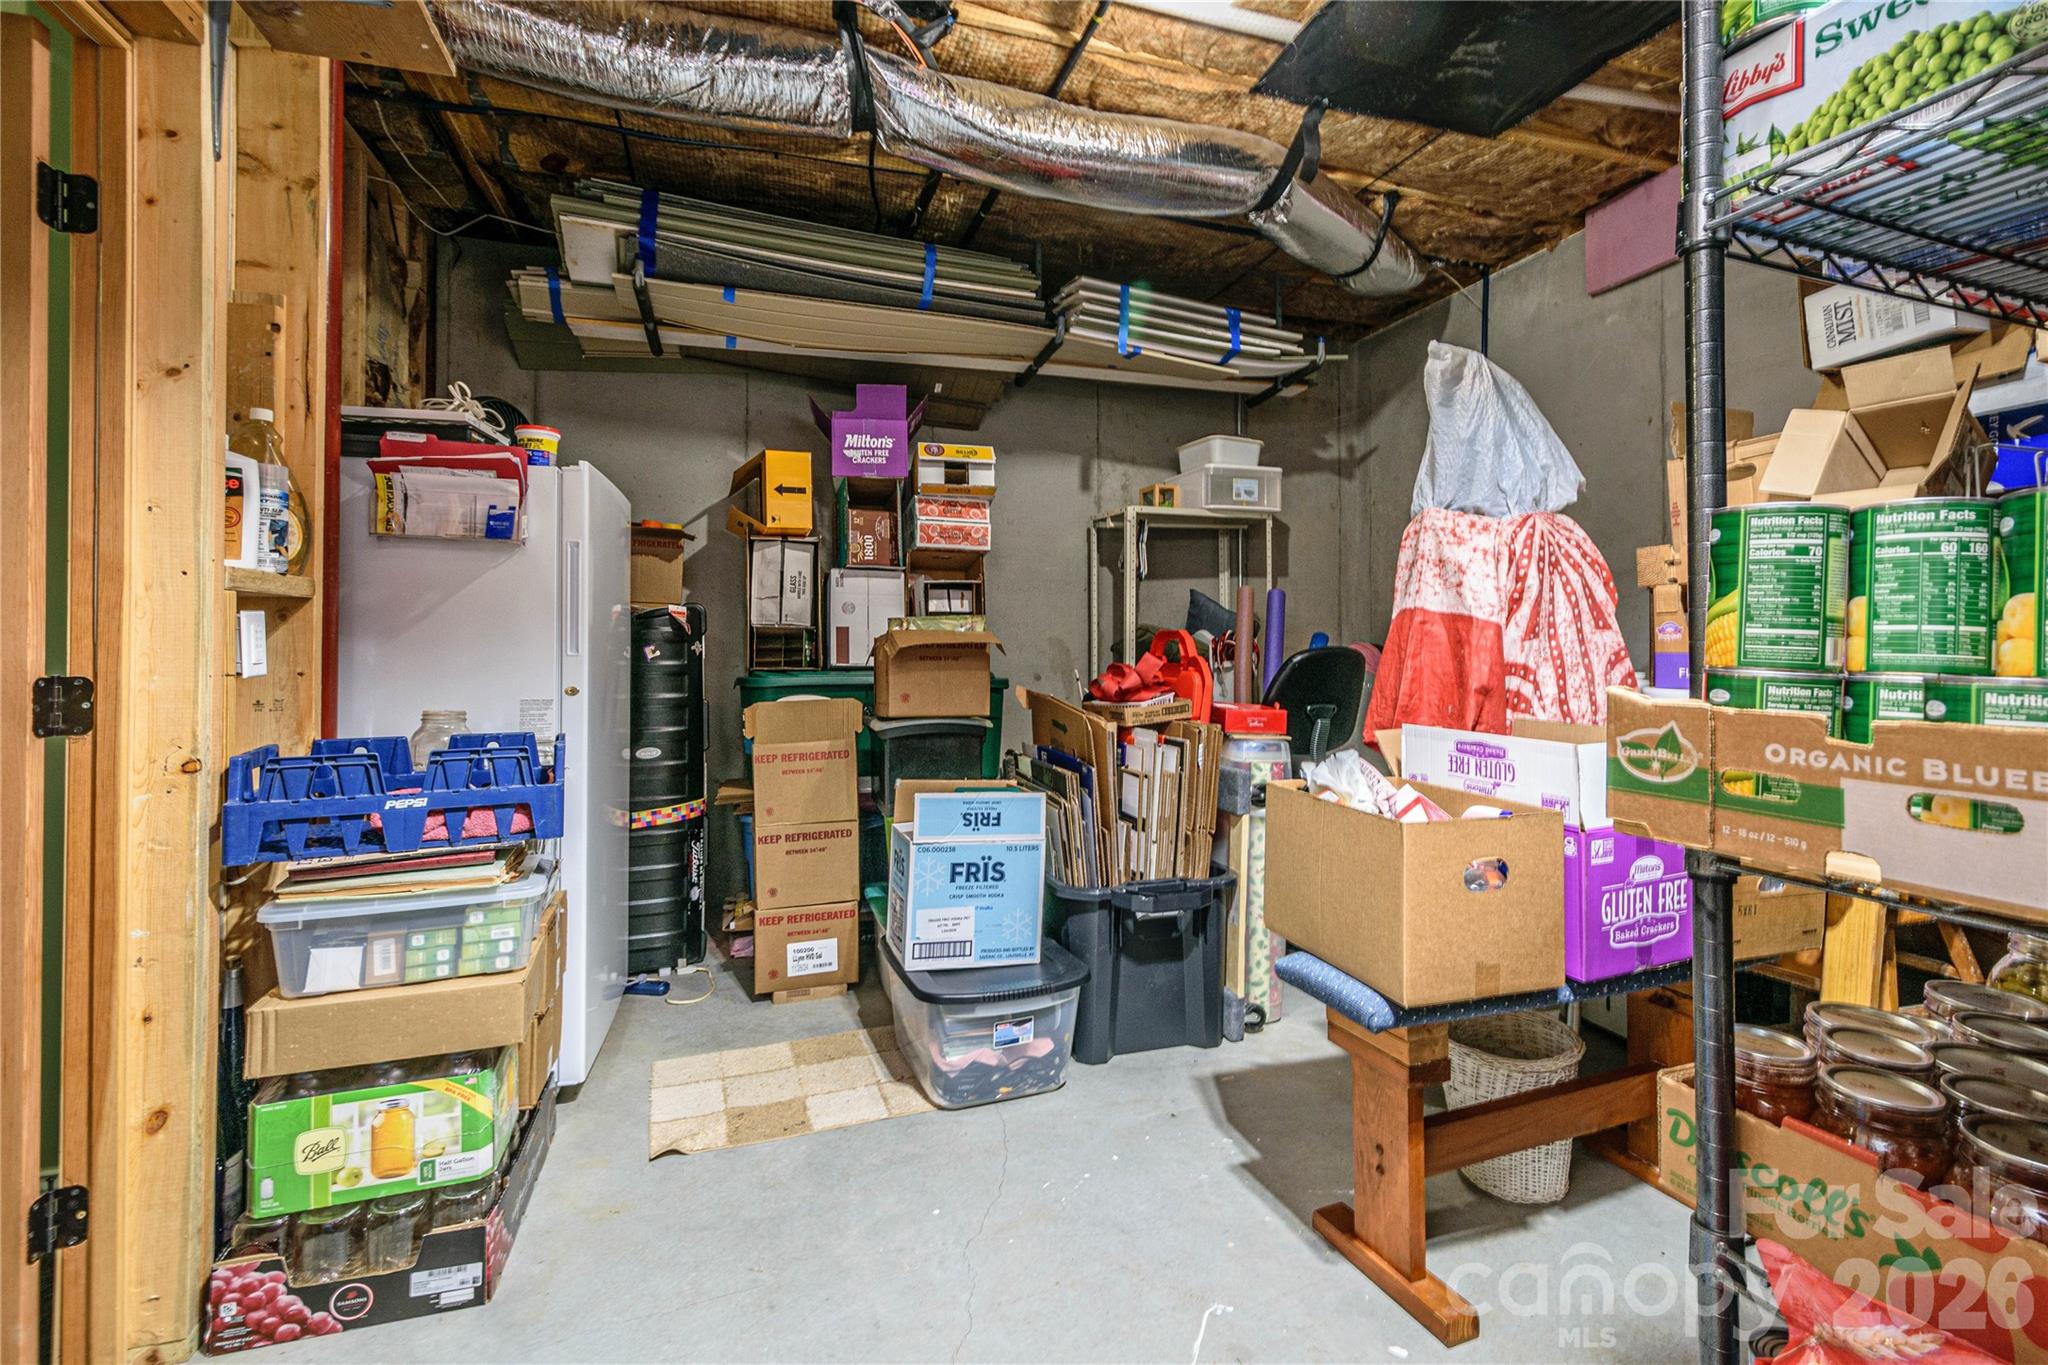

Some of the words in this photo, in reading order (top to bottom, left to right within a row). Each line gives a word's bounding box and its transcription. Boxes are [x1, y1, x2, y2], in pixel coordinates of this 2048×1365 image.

[1823, 303, 1837, 349] CANADIAN
[1834, 299, 1857, 345] MIST
[844, 434, 894, 448] Milton's
[874, 449, 889, 457] FREE
[1751, 516, 1796, 527] Nutrition
[1798, 516, 1824, 525] Facts
[1876, 511, 1935, 524] Nutrition
[1939, 509, 1976, 520] Facts
[864, 535, 873, 560] 1800
[1749, 548, 1786, 557] Calories
[1809, 546, 1822, 556] 70
[1875, 546, 1910, 555] Calories
[1941, 542, 1957, 553] 60
[1969, 542, 1988, 553] 160
[789, 575, 797, 593] GLASS
[1767, 685, 1812, 697] Nutrition
[1813, 687, 1833, 698] Facts
[1985, 712, 2009, 720] Serving
[753, 754, 778, 764] KEEP
[781, 749, 850, 763] REFRIGERATED
[1448, 753, 1470, 775] FREE
[1764, 743, 1907, 777] ORGANIC
[1475, 758, 1517, 782] GLUTEN
[384, 797, 428, 810] PEPSI
[757, 834, 782, 845] KEEP
[784, 829, 853, 843] REFRIGERATED
[1766, 833, 1776, 842] 12
[1784, 836, 1799, 847] 510
[1602, 884, 1653, 925] GLUTEN
[1658, 878, 1687, 914] FREE
[759, 916, 784, 927] KEEP
[787, 909, 856, 924] REFRIGERATED
[787, 929, 811, 937] BETWEEN
[1615, 927, 1638, 942] Baked
[1641, 921, 1675, 936] Crackers
[302, 1137, 341, 1163] Ball
[453, 1156, 474, 1164] Gallon
